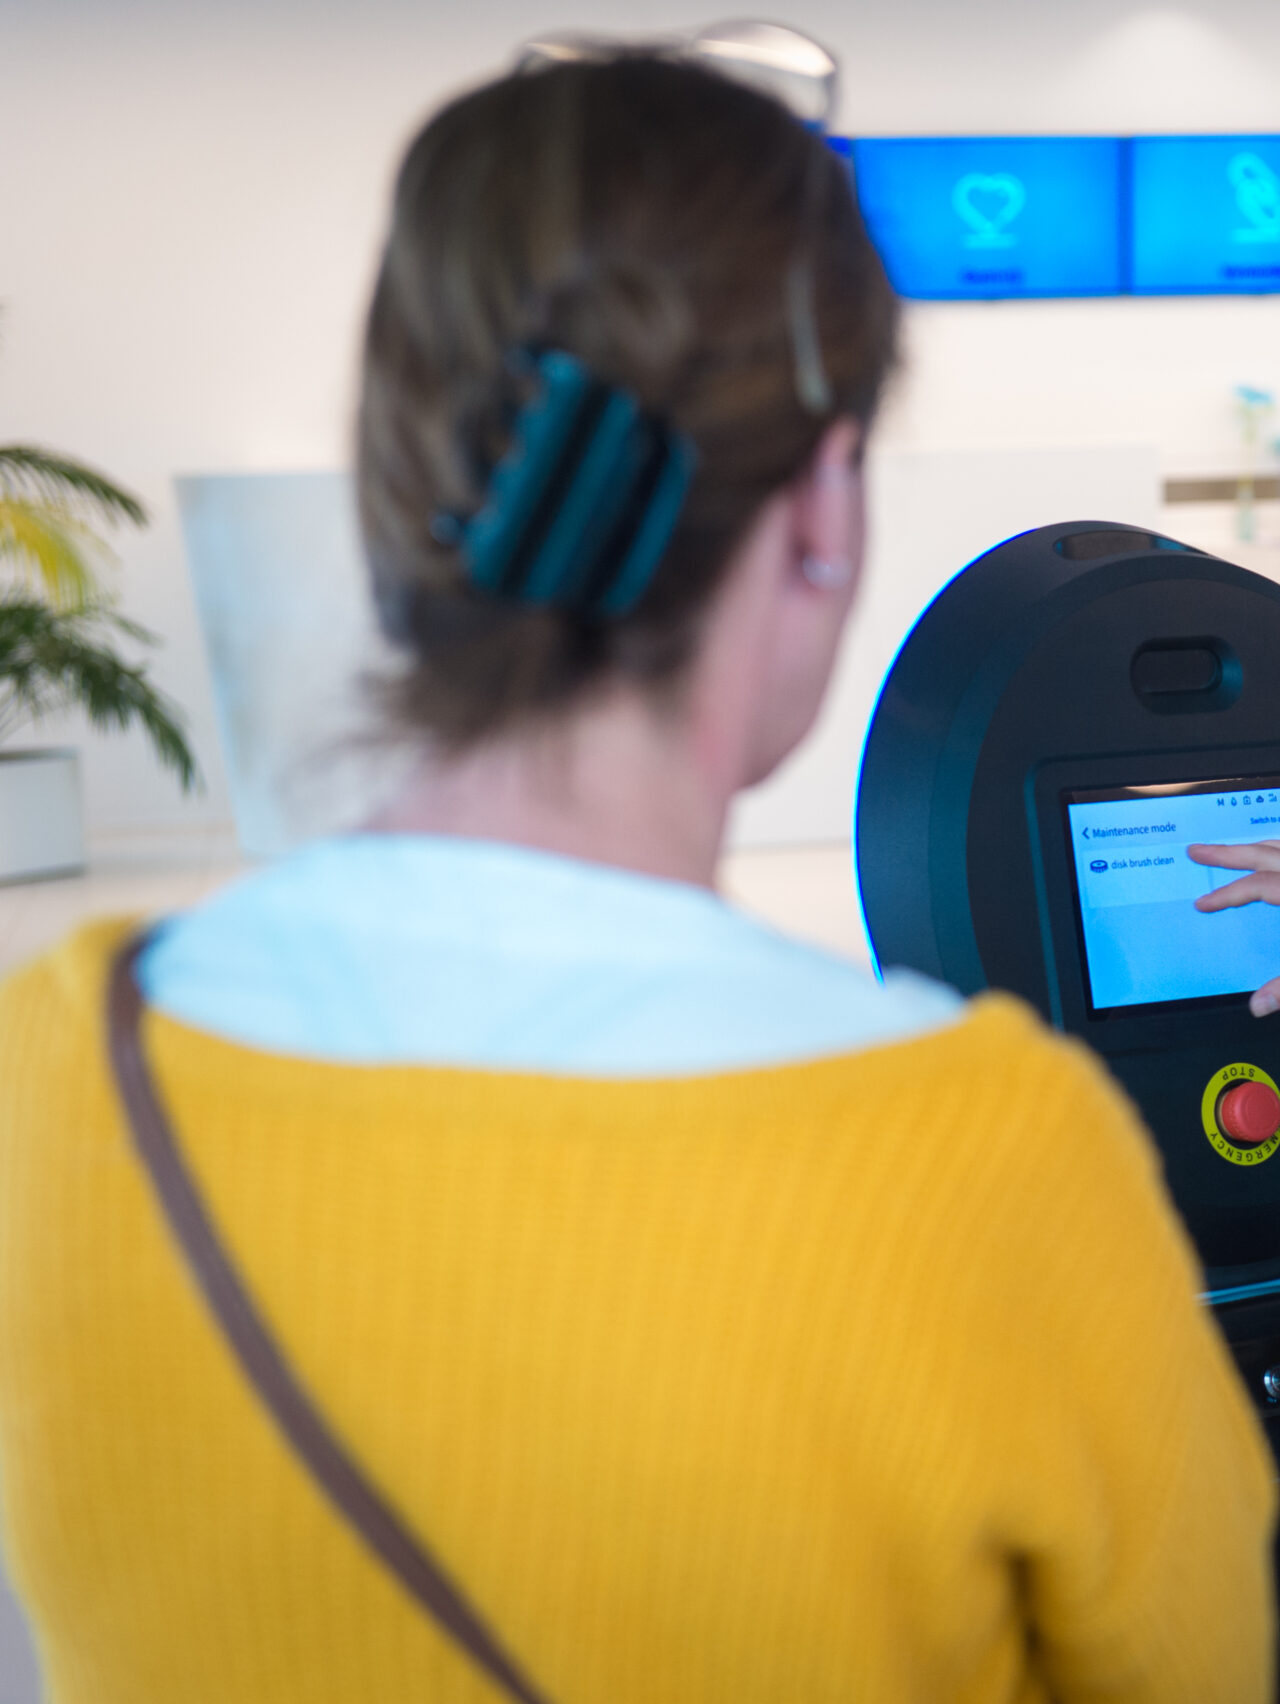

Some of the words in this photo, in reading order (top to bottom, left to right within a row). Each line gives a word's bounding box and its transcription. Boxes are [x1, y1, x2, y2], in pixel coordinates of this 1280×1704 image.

[1092, 825, 1149, 838] Maintenance
[1151, 822, 1176, 833] mode
[1111, 860, 1128, 870] disk
[1129, 857, 1152, 868] brush
[1153, 856, 1174, 866] clean
[1222, 1067, 1255, 1081] STOP
